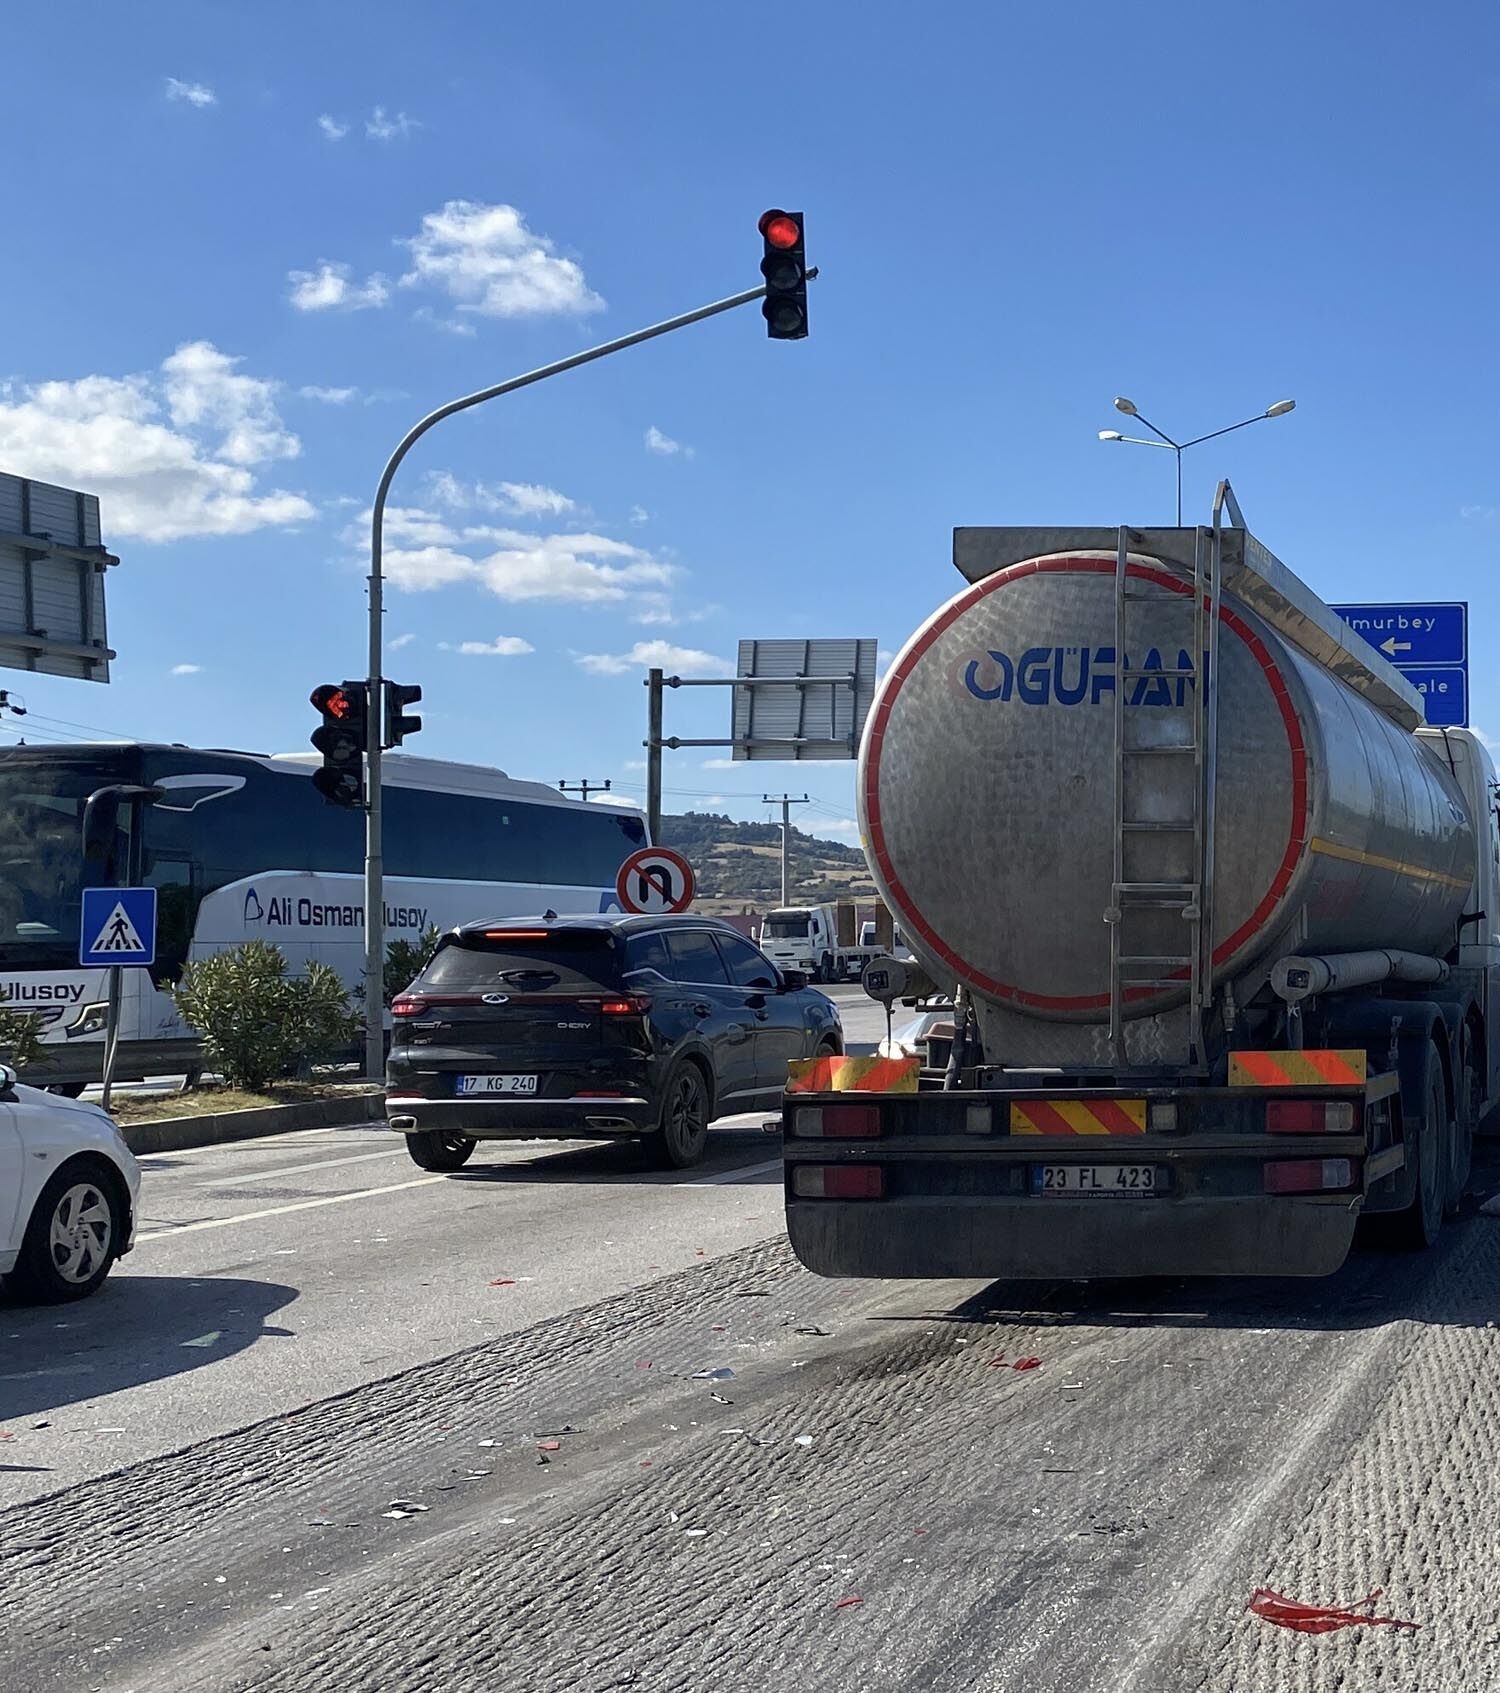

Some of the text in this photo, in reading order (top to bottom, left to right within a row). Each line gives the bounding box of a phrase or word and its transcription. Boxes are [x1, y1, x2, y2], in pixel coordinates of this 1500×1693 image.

[267, 898, 428, 933] Ali Osman lusoy
[464, 1077, 535, 1091] 17 KG 240
[1044, 1168, 1152, 1188] 23 FL 423
